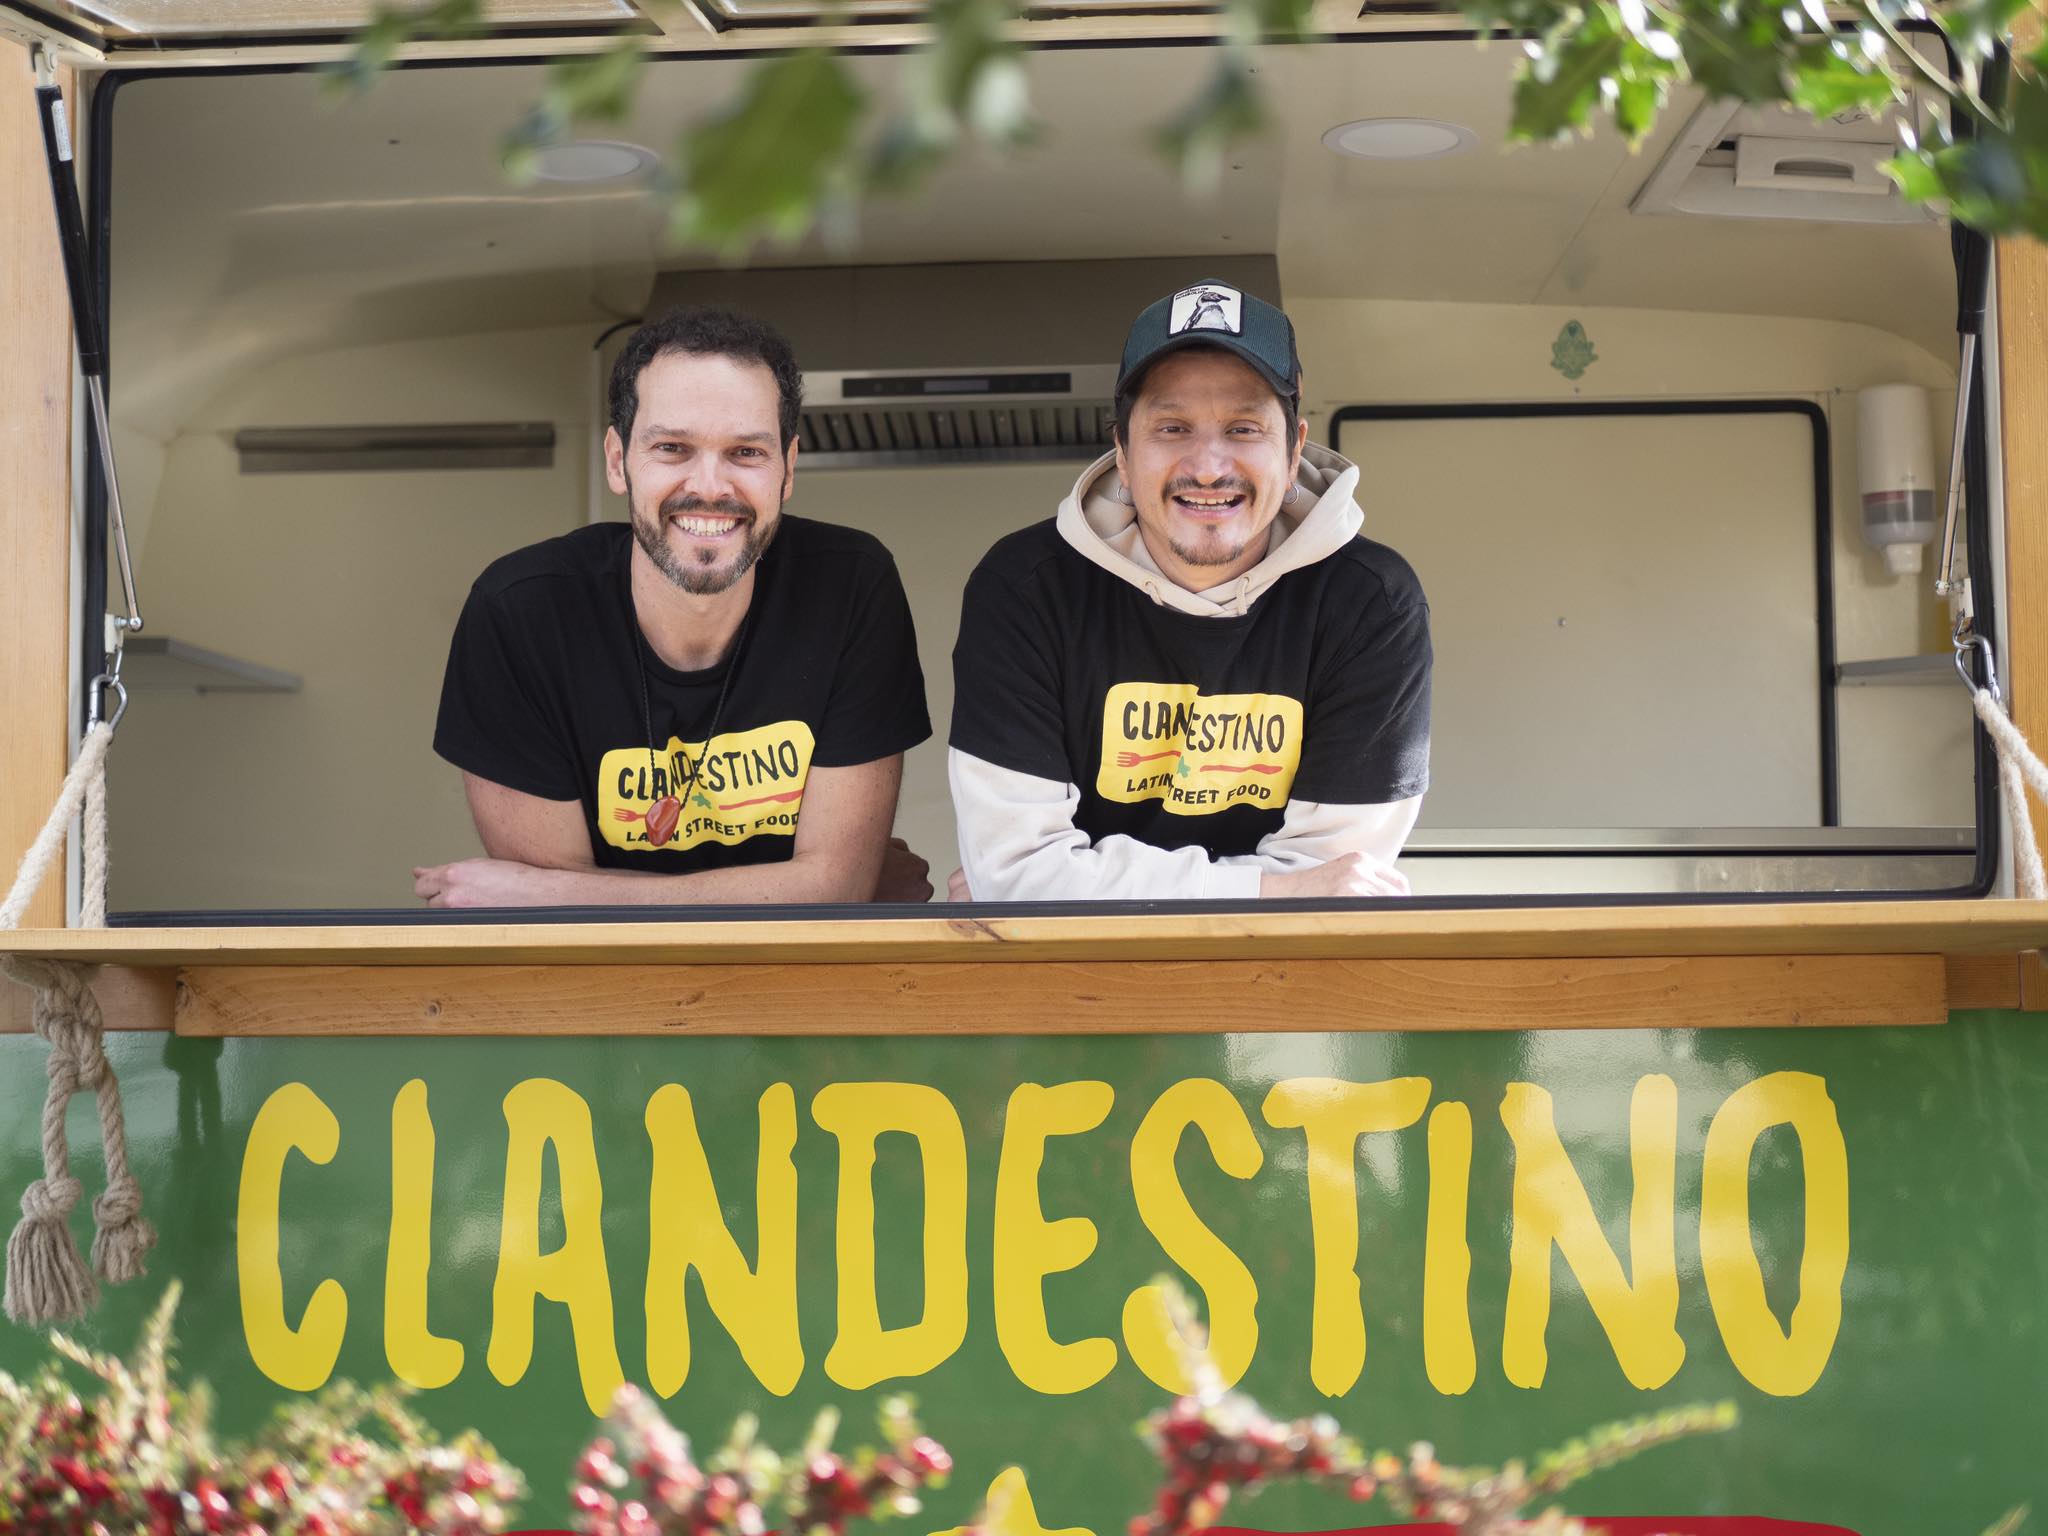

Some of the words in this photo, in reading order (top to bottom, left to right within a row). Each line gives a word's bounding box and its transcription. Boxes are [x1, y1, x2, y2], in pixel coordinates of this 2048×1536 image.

[1123, 701, 1285, 753] CLANESTINO
[618, 740, 798, 799] CLANDESTINO
[1127, 774, 1173, 792] LATIN
[1168, 785, 1219, 804] REET
[1227, 784, 1271, 802] FOOD
[626, 831, 679, 842] LAN
[686, 818, 747, 838] STREET
[755, 812, 799, 828] FOOD
[237, 1071, 1850, 1419] CLANDESTINO
